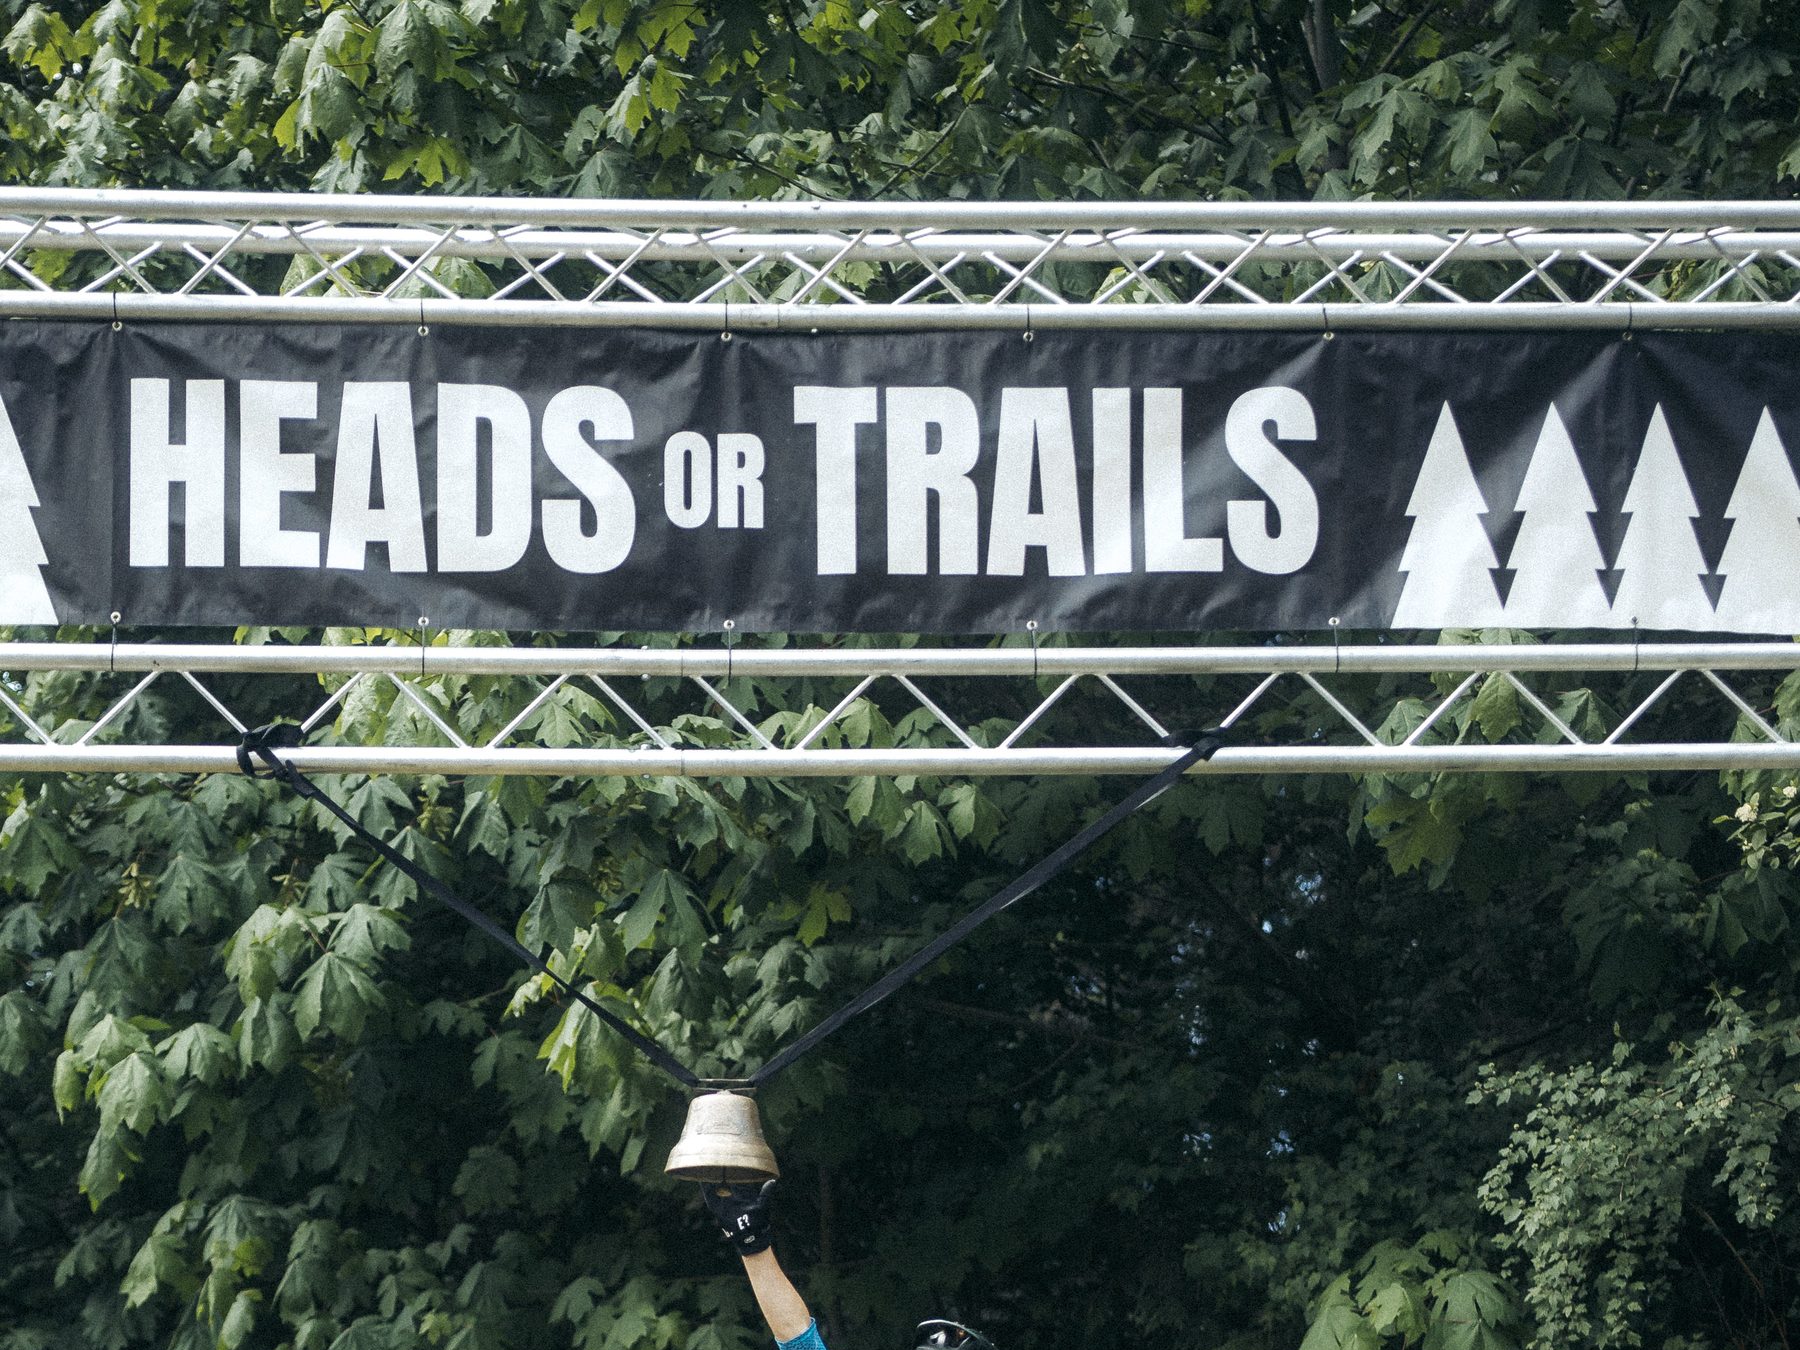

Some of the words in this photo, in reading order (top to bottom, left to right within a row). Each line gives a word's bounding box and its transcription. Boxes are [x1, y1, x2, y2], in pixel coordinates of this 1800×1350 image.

[129, 376, 637, 576] HEADS
[663, 430, 766, 530] OR
[793, 385, 1321, 577] TRAILS
